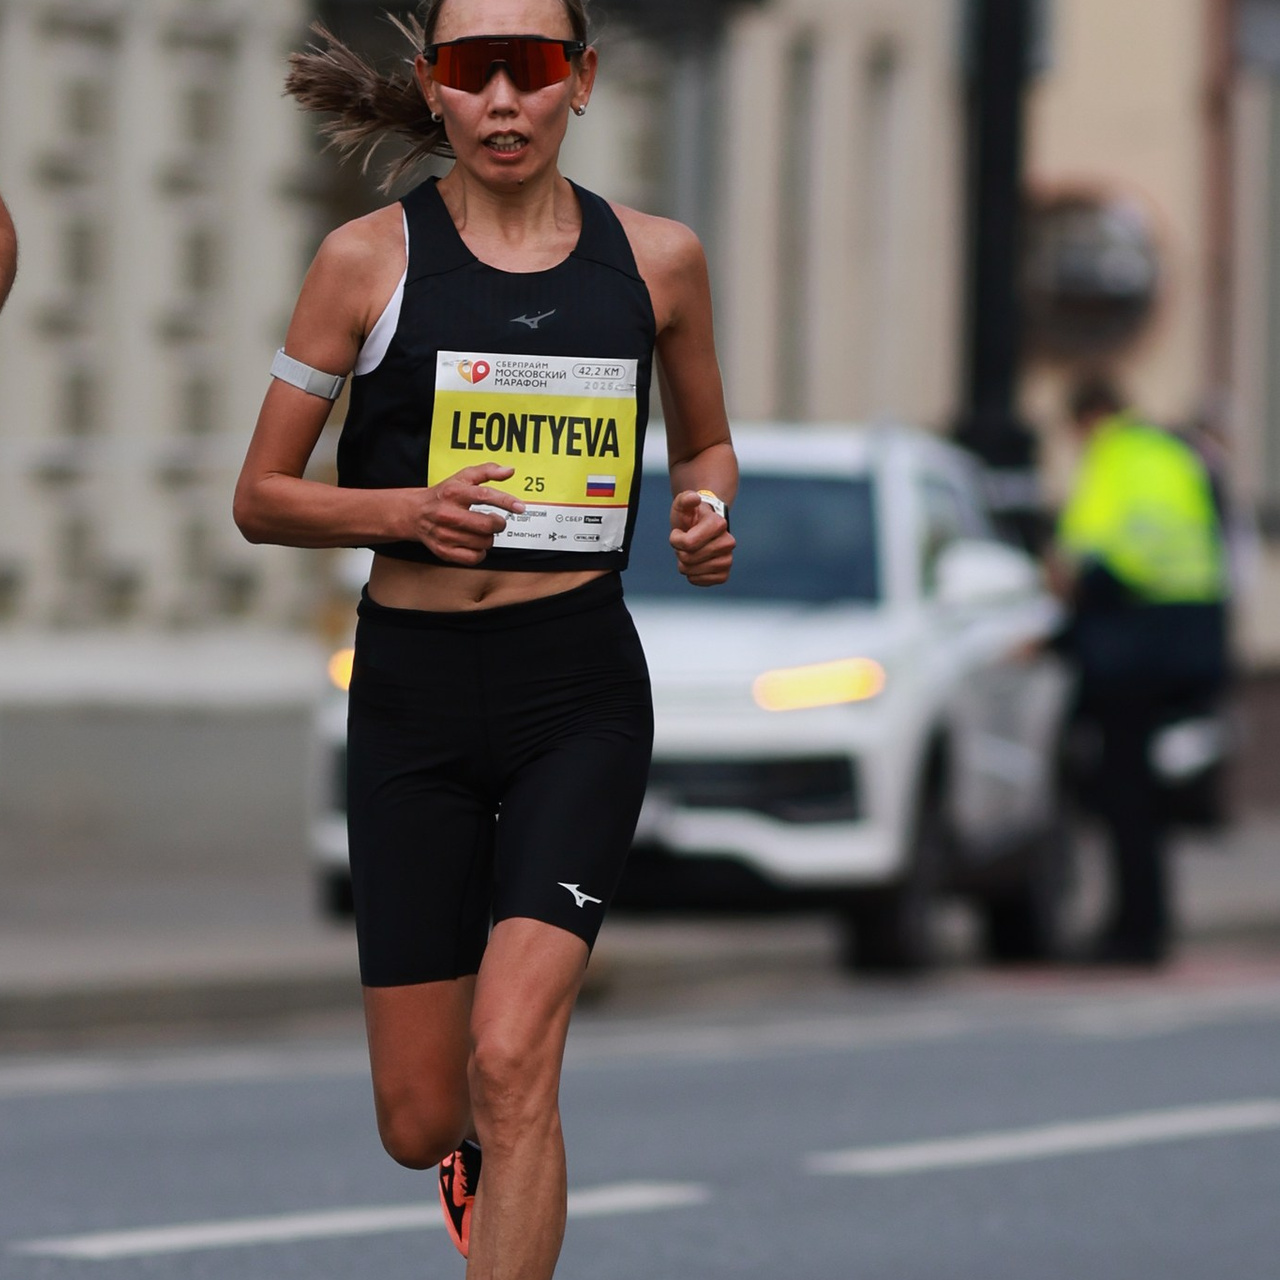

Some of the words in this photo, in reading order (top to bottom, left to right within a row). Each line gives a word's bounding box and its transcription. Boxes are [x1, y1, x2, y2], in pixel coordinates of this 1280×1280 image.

[495, 360, 549, 369] СБЕРПРАЙМ
[495, 369, 567, 380] МОСКОВСКИЙ
[578, 366, 600, 377] 42,2
[494, 378, 548, 388] МАРАФОН
[450, 410, 620, 458] LEONTYEVA
[524, 476, 545, 493] 25
[564, 515, 583, 523] СБЕР
